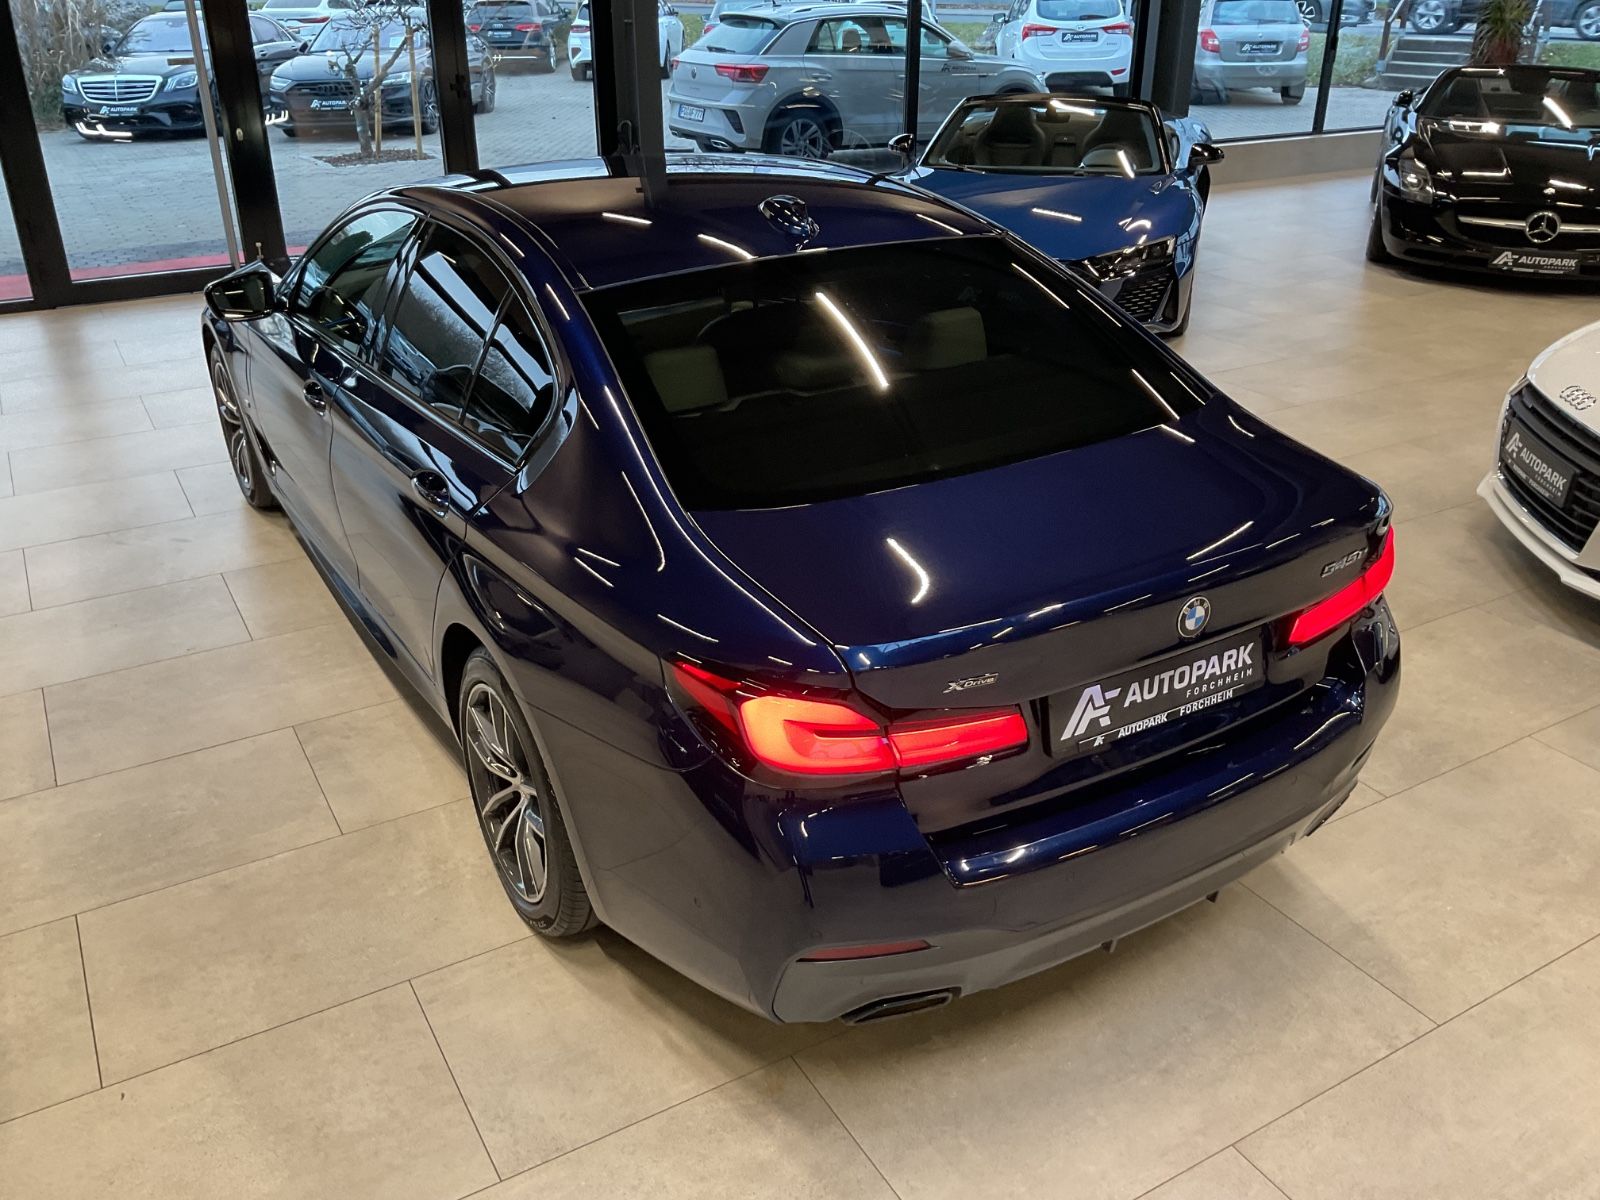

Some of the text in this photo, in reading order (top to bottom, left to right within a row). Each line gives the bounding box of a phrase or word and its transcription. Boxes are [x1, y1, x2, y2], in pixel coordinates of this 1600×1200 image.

[1518, 255, 1579, 267] AUTOPARK
[1520, 447, 1568, 491] AUTOPARK
[1123, 642, 1255, 708] AUTOPARK
[1186, 667, 1253, 698] FORCHHEIM
[1117, 712, 1168, 739] AUTOPARK
[1179, 689, 1233, 716] FORCHHEIM
